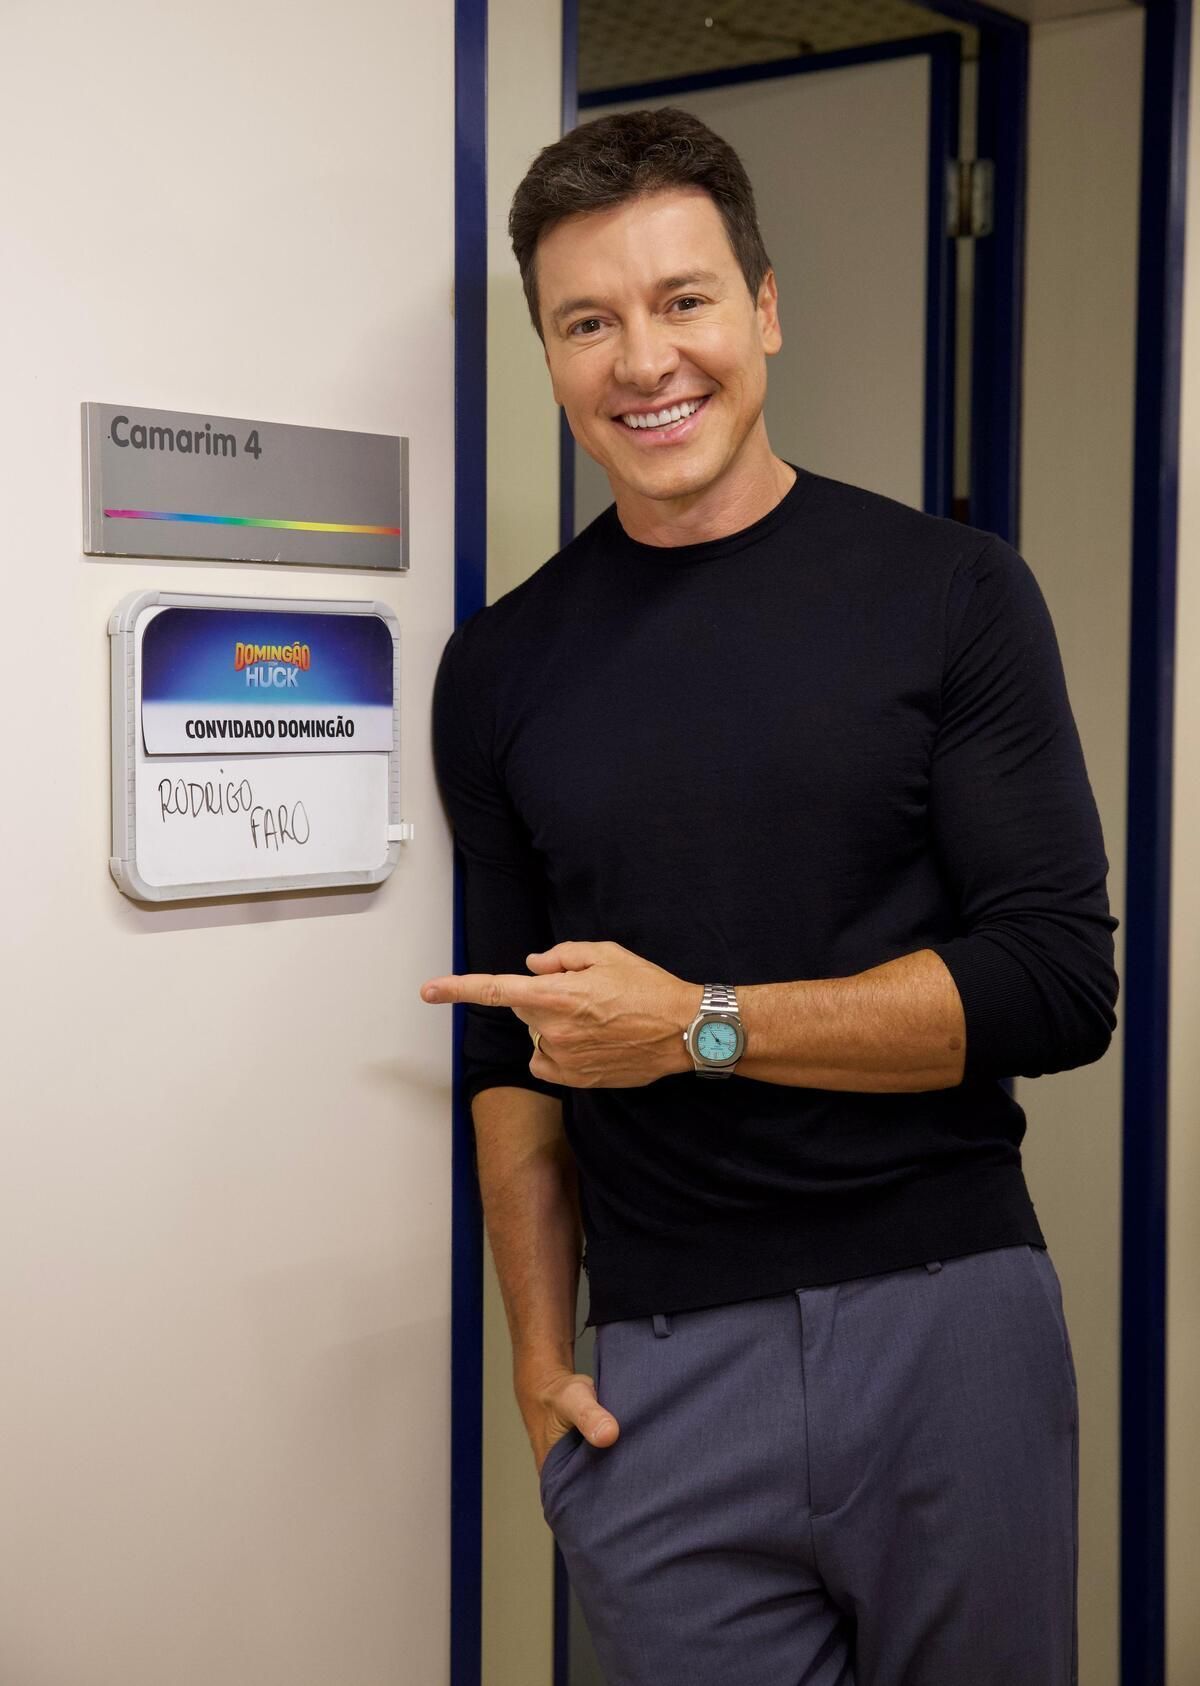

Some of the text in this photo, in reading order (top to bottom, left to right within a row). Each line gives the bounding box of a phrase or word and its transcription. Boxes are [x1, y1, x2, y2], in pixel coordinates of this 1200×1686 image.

[110, 416, 262, 460] Camarim 4
[234, 641, 311, 672] DOMINGÃO
[246, 666, 299, 688] HUCK
[185, 715, 355, 739] CONVIDADO DOMINGÃO
[250, 800, 310, 851] FARO
